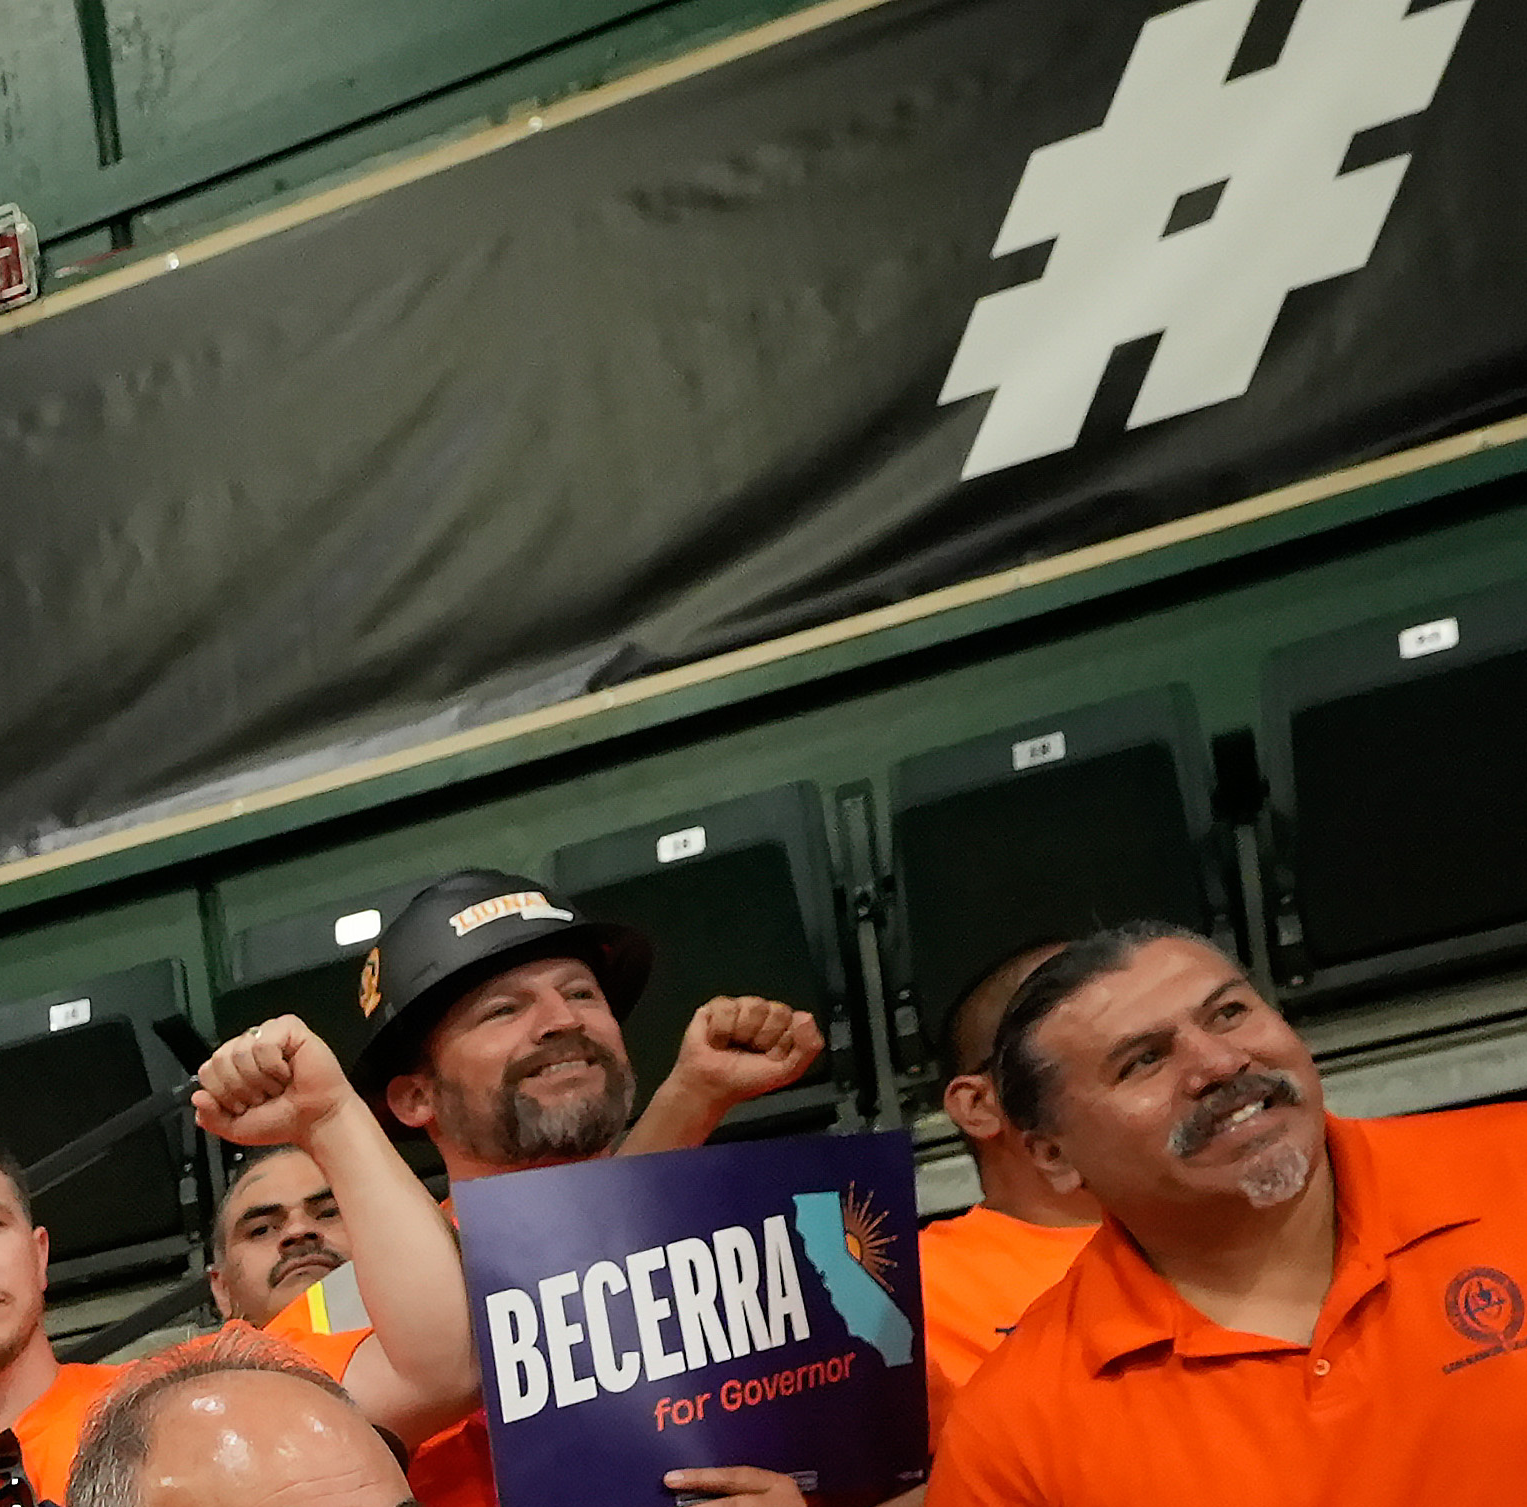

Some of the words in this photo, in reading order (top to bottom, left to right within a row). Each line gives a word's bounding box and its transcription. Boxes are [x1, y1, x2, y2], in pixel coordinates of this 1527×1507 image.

[486, 1215, 809, 1423] BECERRA
[656, 1393, 710, 1430] for
[720, 1353, 854, 1411] Governor
